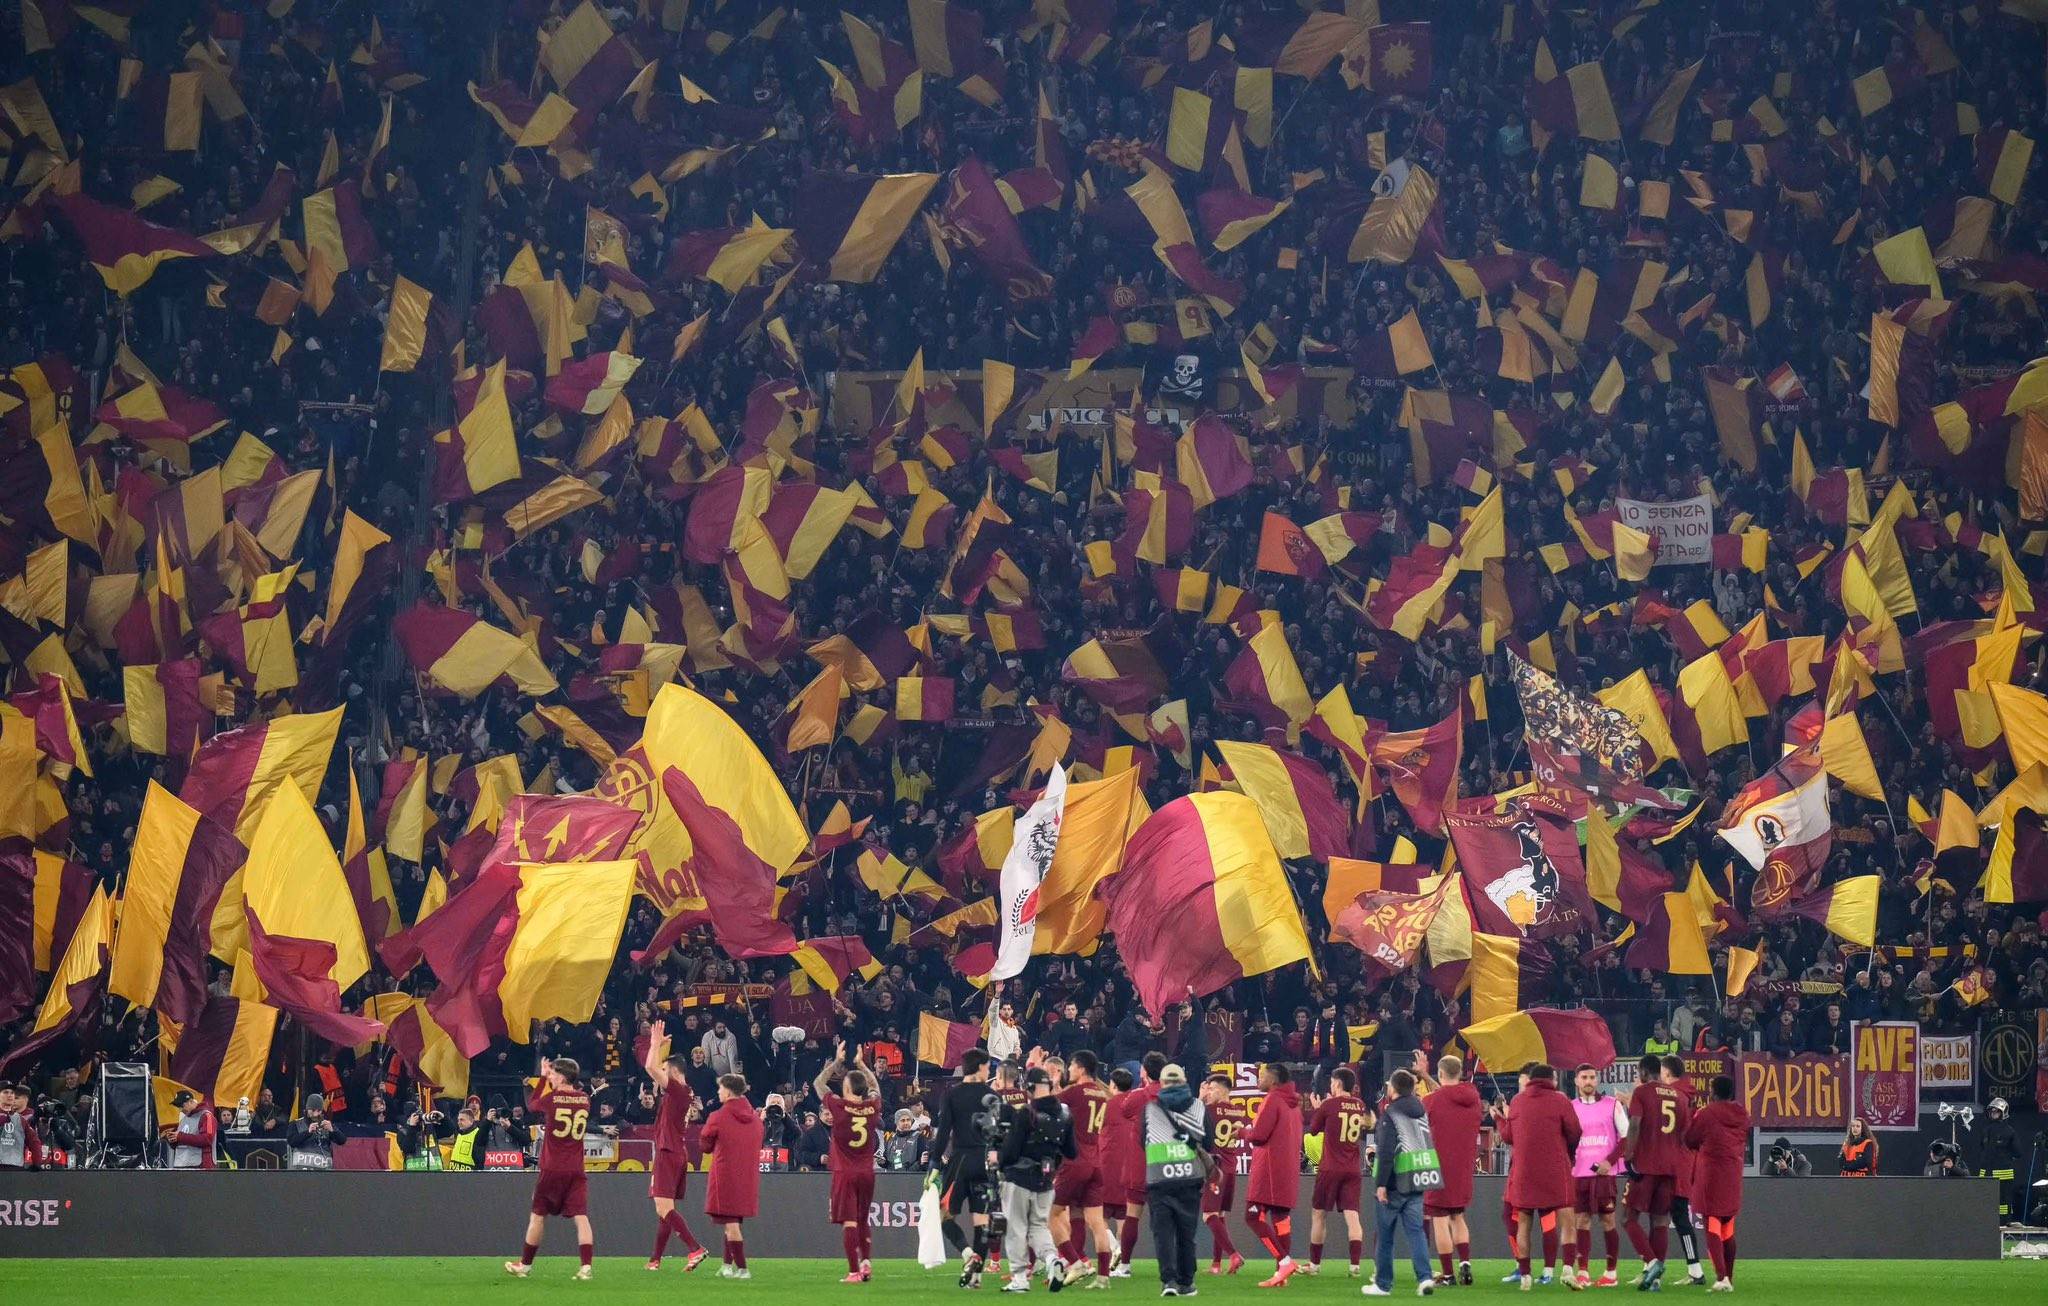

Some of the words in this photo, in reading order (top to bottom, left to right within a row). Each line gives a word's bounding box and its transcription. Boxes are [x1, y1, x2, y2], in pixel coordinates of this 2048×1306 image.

[1623, 506, 1640, 521] IO
[1648, 504, 1706, 519] SENZA
[1674, 522, 1709, 537] NON
[1856, 1027, 1914, 1073] AVE
[1923, 1042, 1953, 1060] FIGLI
[1956, 1042, 1970, 1059] DI
[1699, 1060, 1723, 1074] CORE
[1924, 1062, 1971, 1082] ROMA
[1875, 1082, 1895, 1093] ASR
[1874, 1094, 1898, 1107] 1927
[552, 1107, 589, 1141] 56
[1087, 1100, 1107, 1135] 14
[1661, 1101, 1676, 1134] 5
[848, 1116, 868, 1148] 3
[1338, 1112, 1360, 1143] 18
[1167, 1144, 1188, 1158] HB
[297, 1153, 329, 1167] PITCH
[1412, 1152, 1431, 1167] HB
[1163, 1162, 1193, 1178] 039
[1413, 1171, 1440, 1186] 060
